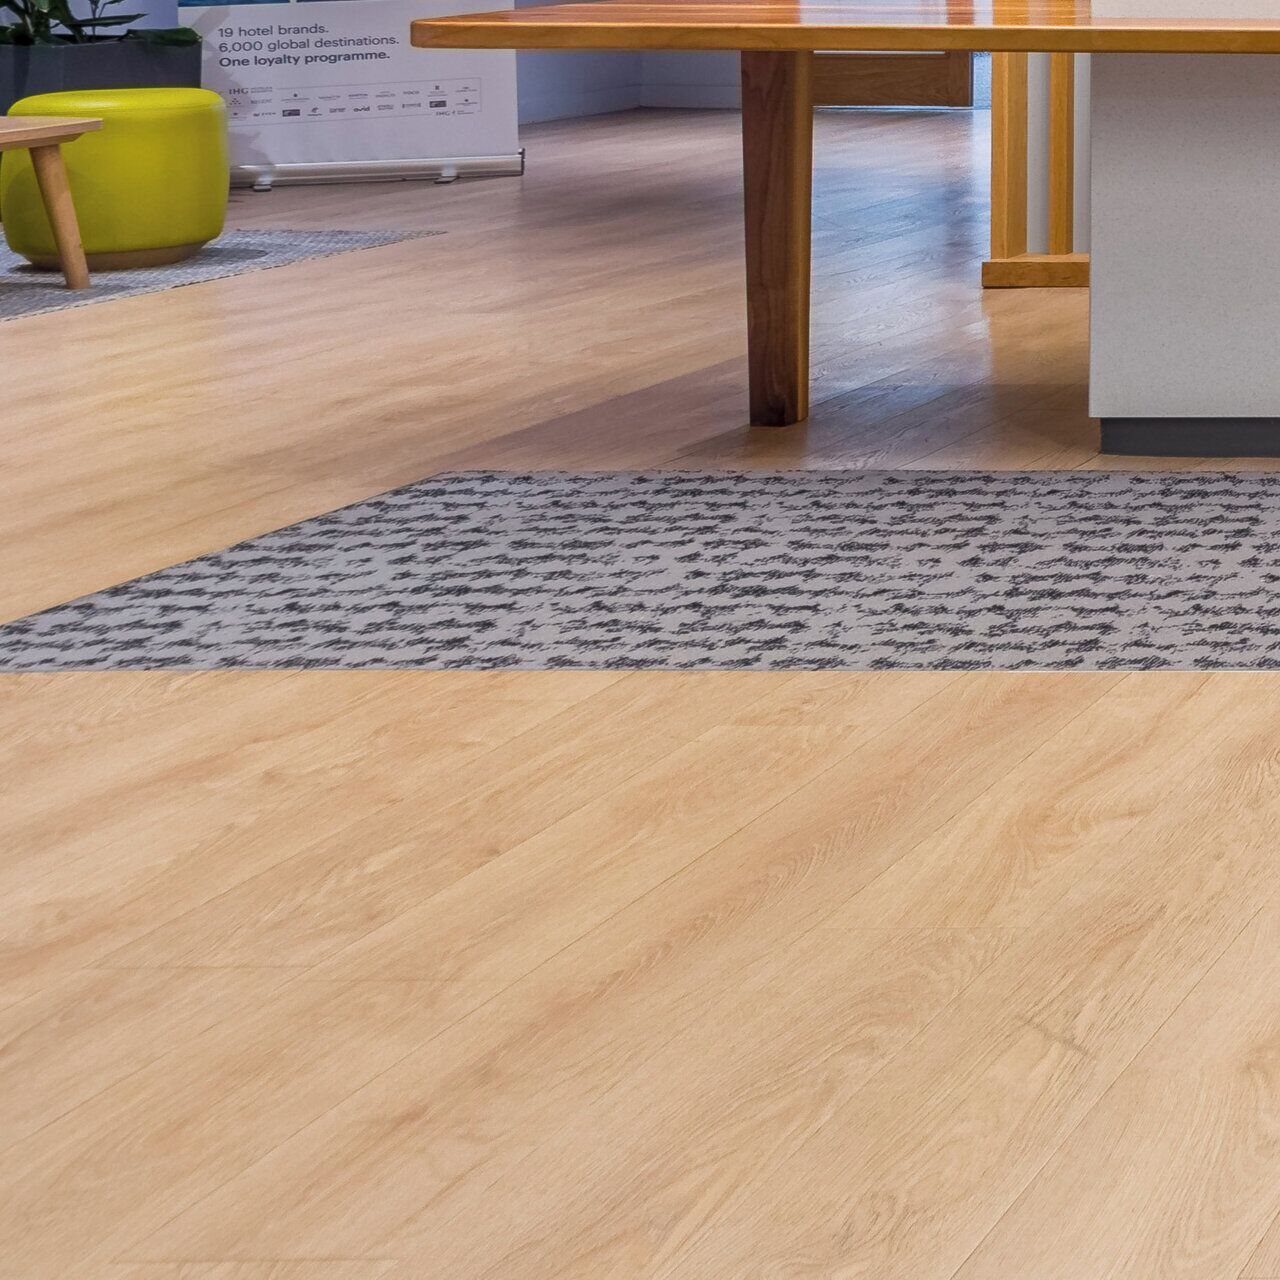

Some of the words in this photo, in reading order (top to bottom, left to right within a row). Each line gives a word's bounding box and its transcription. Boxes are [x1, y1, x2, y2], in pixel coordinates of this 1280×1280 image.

[218, 28, 234, 37] 19
[238, 25, 274, 37] hotel
[278, 23, 329, 35] brands.
[218, 41, 263, 53] 6,000
[267, 39, 310, 52] global
[314, 35, 400, 48] destinations.
[219, 56, 250, 67] One
[254, 53, 301, 66] loyalty
[304, 50, 391, 64] programme.
